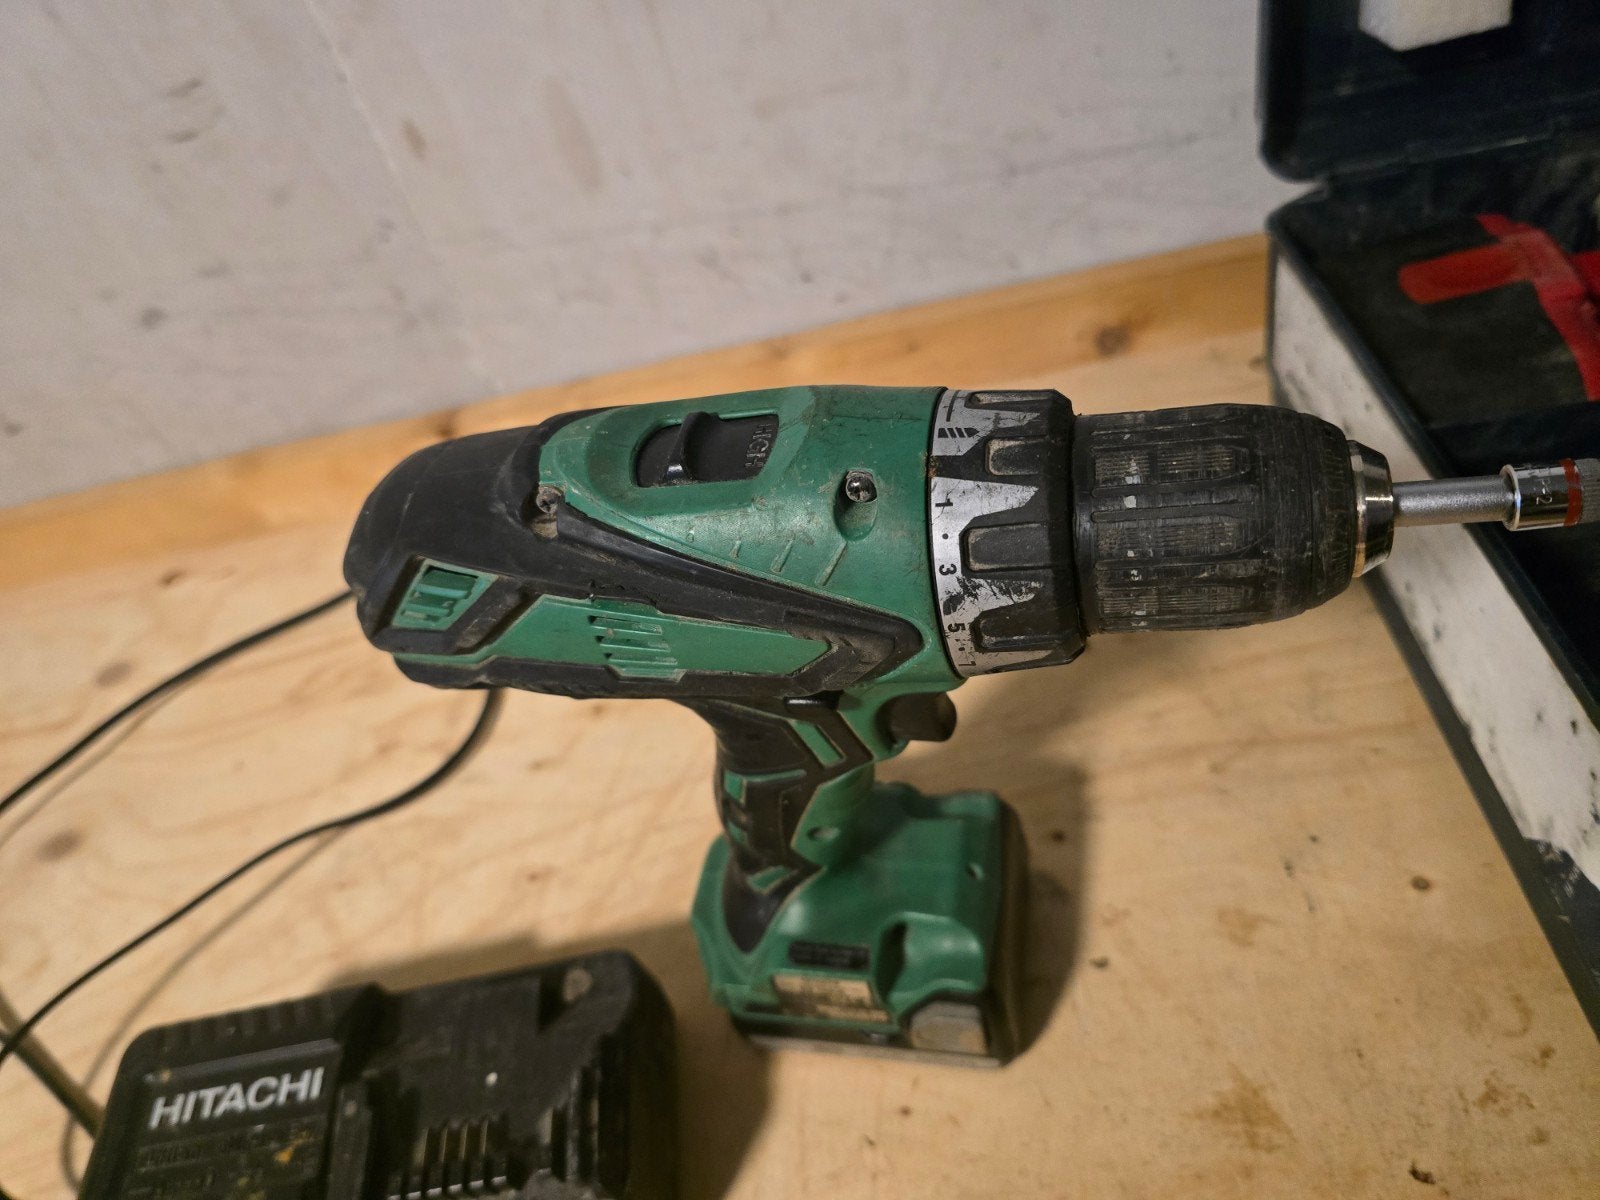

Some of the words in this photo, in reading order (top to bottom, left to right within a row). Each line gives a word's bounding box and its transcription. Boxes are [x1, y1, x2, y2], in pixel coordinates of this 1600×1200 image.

[935, 498, 953, 508] 1
[939, 563, 957, 576] 3
[947, 622, 966, 633] 5
[148, 1067, 325, 1130] HITACHI
